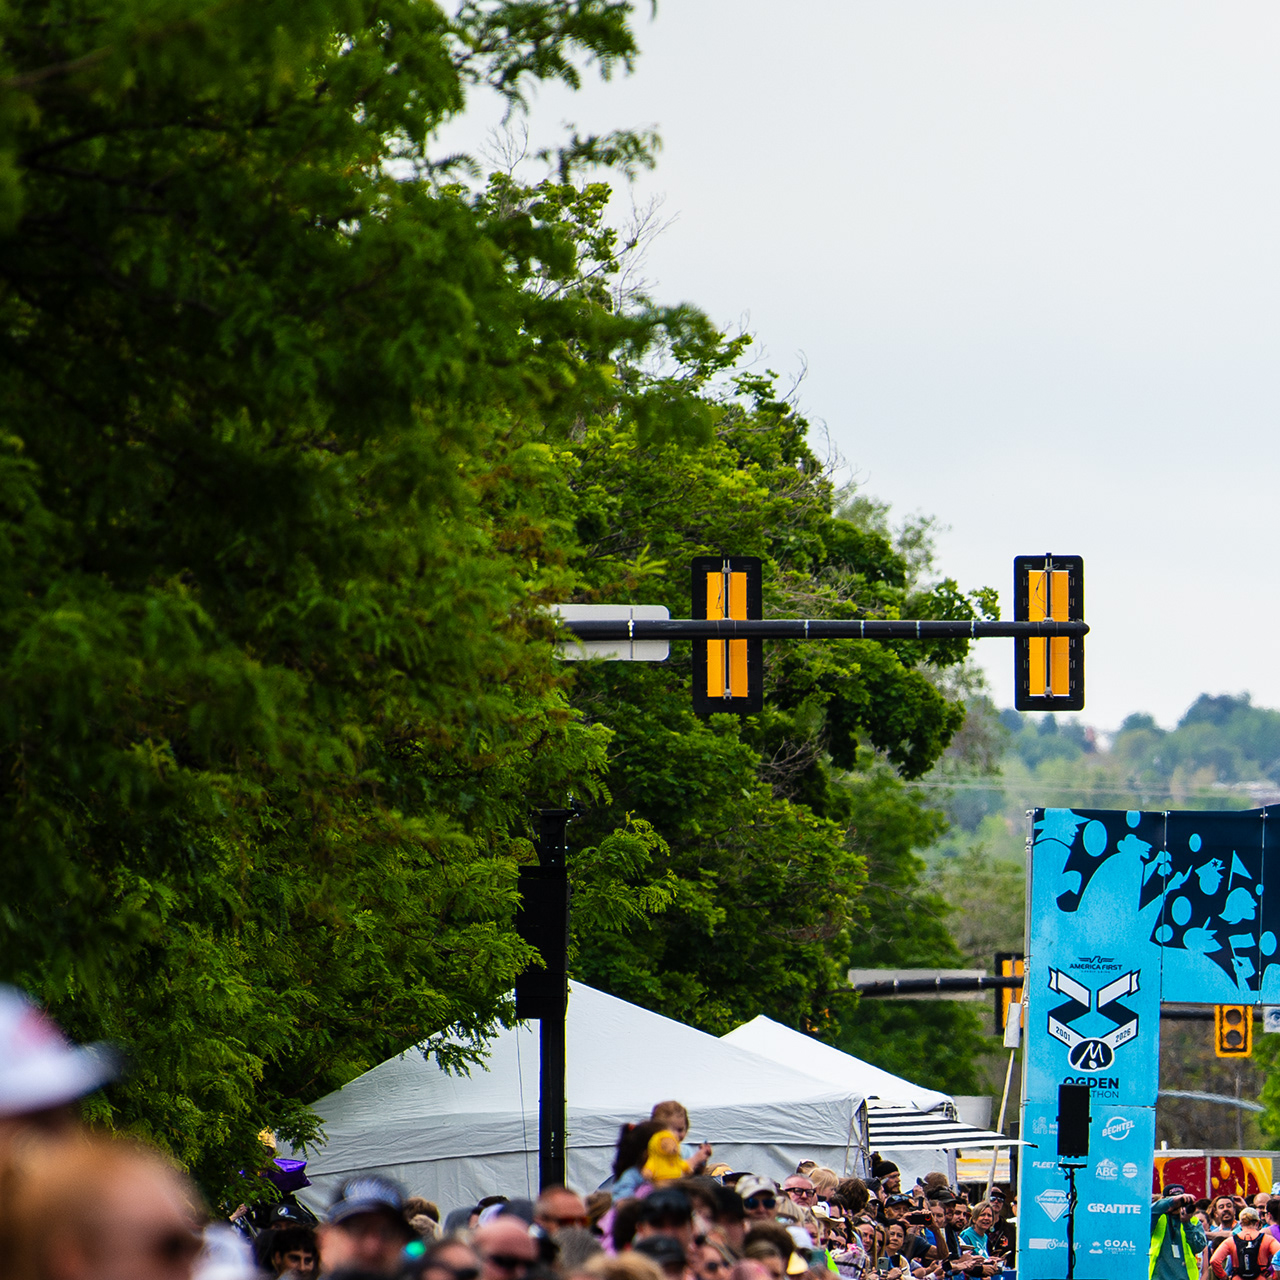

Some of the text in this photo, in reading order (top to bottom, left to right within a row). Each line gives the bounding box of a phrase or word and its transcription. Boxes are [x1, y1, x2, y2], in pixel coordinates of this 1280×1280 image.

[1055, 1026, 1071, 1042] 2001
[1115, 1027, 1132, 1043] 2026
[1102, 1120, 1135, 1137] BECHTEL
[1095, 1167, 1118, 1177] ABC
[1087, 1203, 1142, 1214] GRANITE
[1104, 1239, 1136, 1248] GOAL
